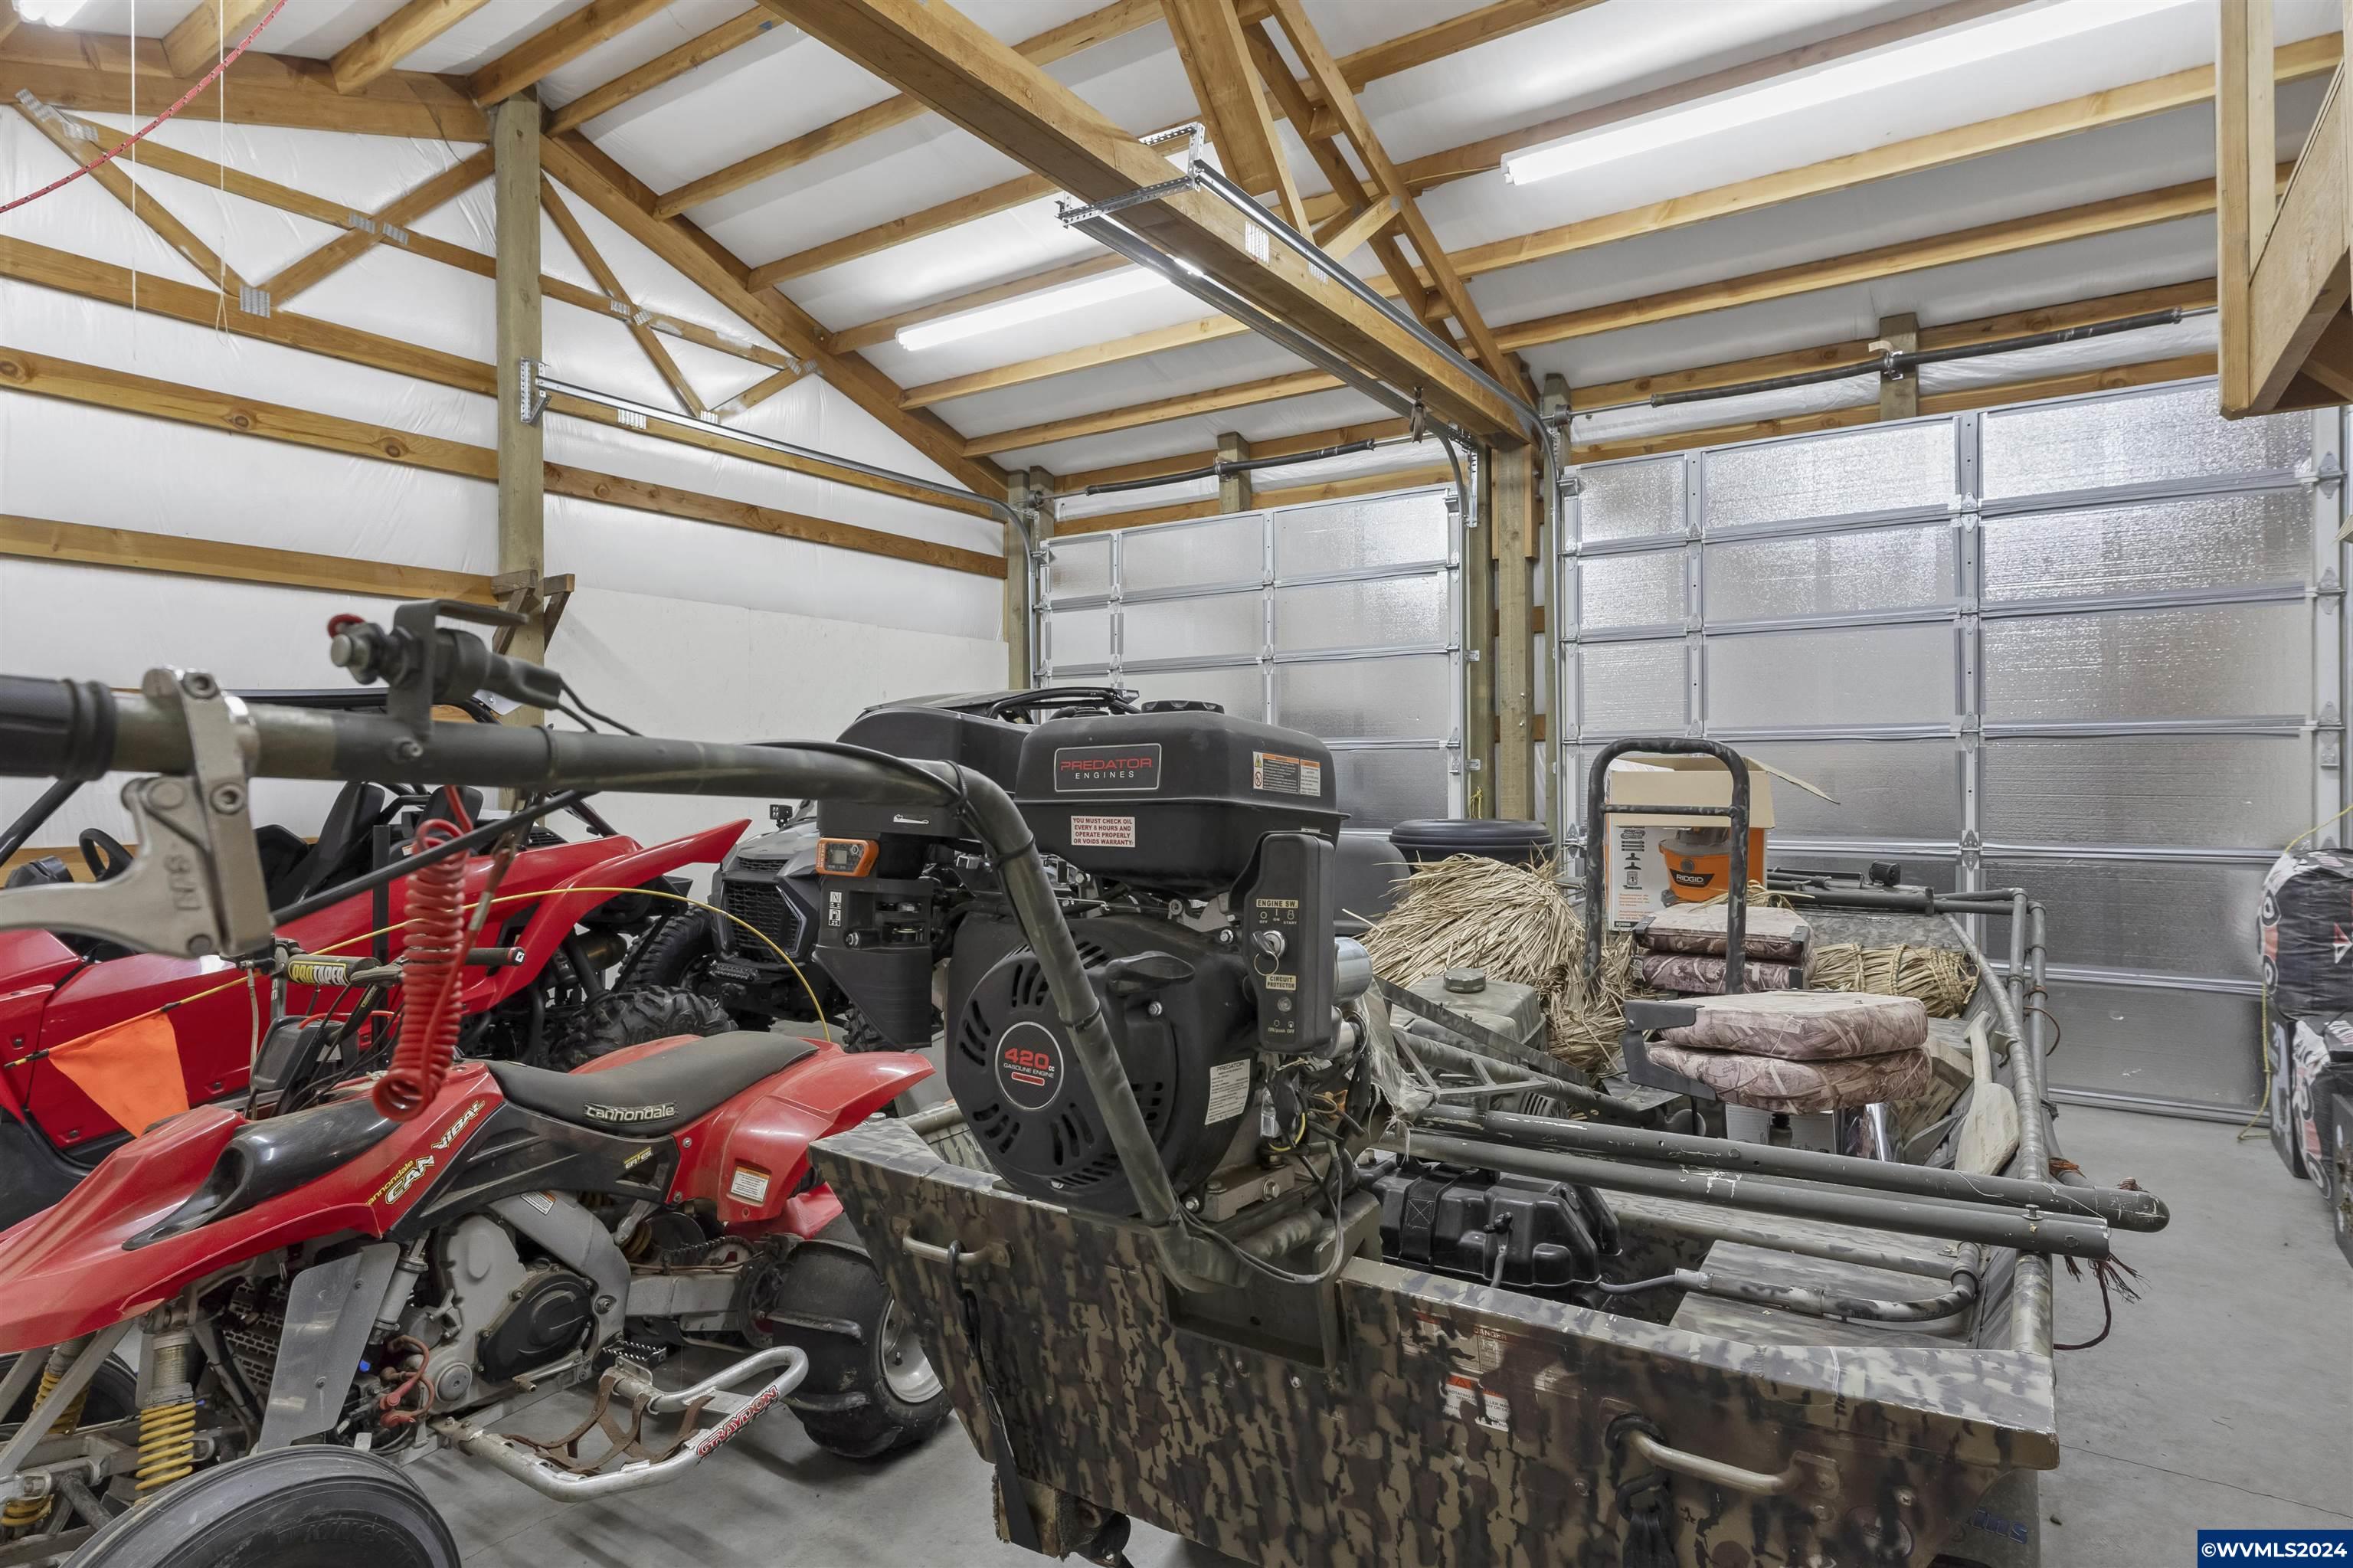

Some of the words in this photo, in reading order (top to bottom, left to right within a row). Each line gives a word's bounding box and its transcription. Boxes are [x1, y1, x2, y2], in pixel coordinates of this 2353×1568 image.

[1060, 758, 1152, 771] PREDATOR
[1075, 771, 1134, 779] ENGINES
[1676, 874, 1703, 882] RIDGID
[292, 964, 349, 987] PROTAPER
[1005, 1048, 1049, 1070] 420
[1216, 1061, 1245, 1072] PREDATOR
[1003, 1062, 1032, 1073] GASOLINE
[1033, 1069, 1054, 1079] ENGINE
[584, 1104, 676, 1121] cannondale
[385, 1155, 435, 1204] CAN
[1473, 1327, 1507, 1340] DANGER
[697, 1385, 779, 1458] GRAYDON
